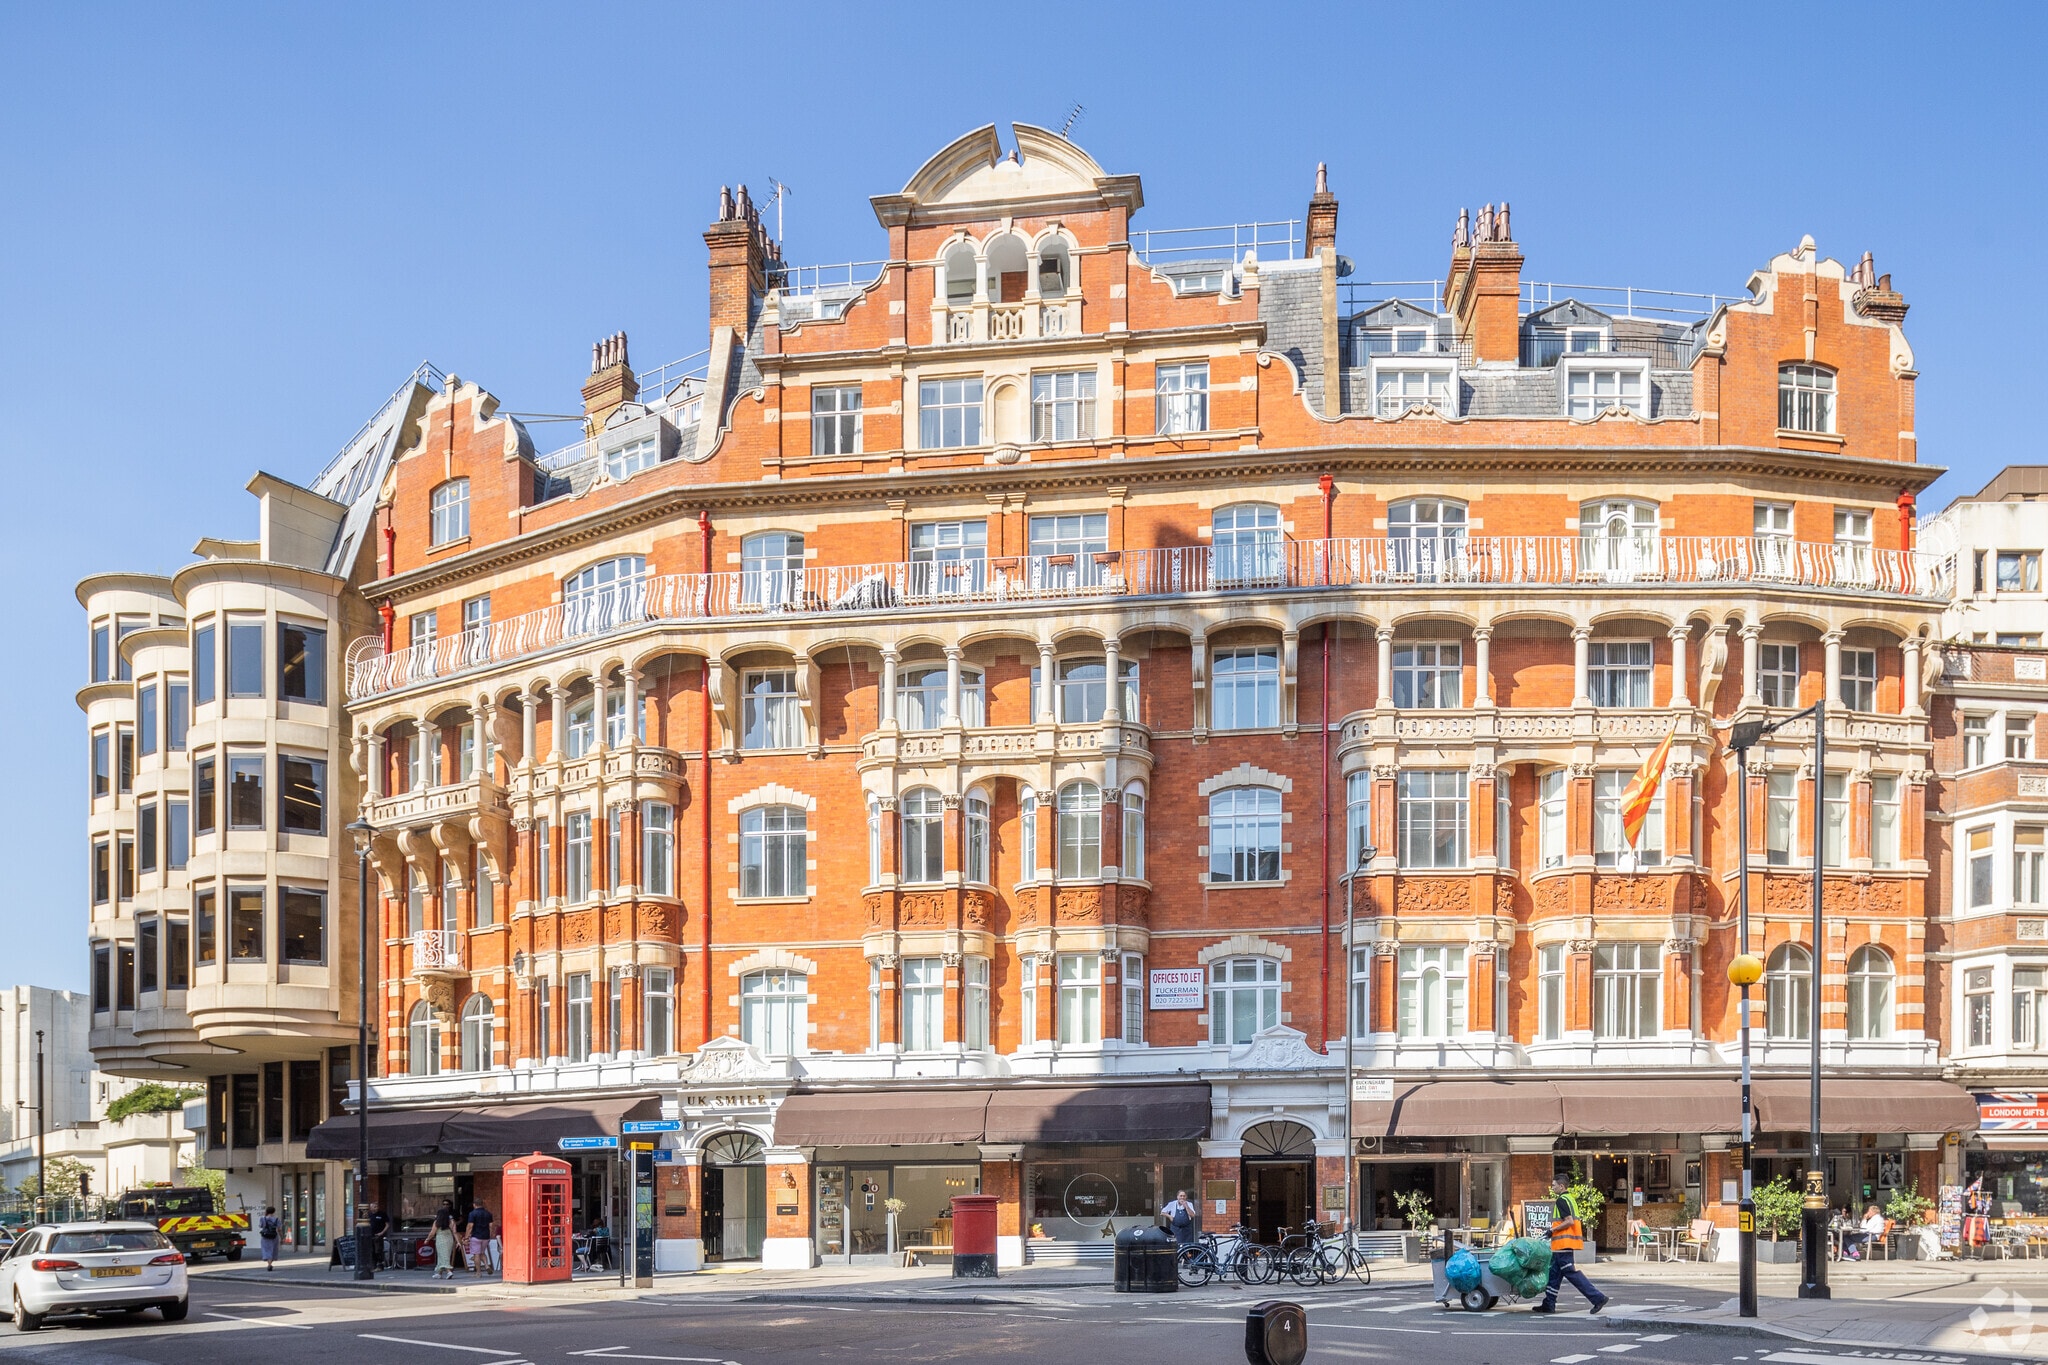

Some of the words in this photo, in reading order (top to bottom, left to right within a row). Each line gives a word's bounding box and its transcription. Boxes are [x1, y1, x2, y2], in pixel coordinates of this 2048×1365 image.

[1153, 973, 1178, 983] OFFICES
[1180, 973, 1188, 983] TO
[1190, 973, 1201, 982] LET
[687, 1096, 707, 1106] UK
[715, 1095, 767, 1106] SMILE
[1284, 1320, 1291, 1331] 4
